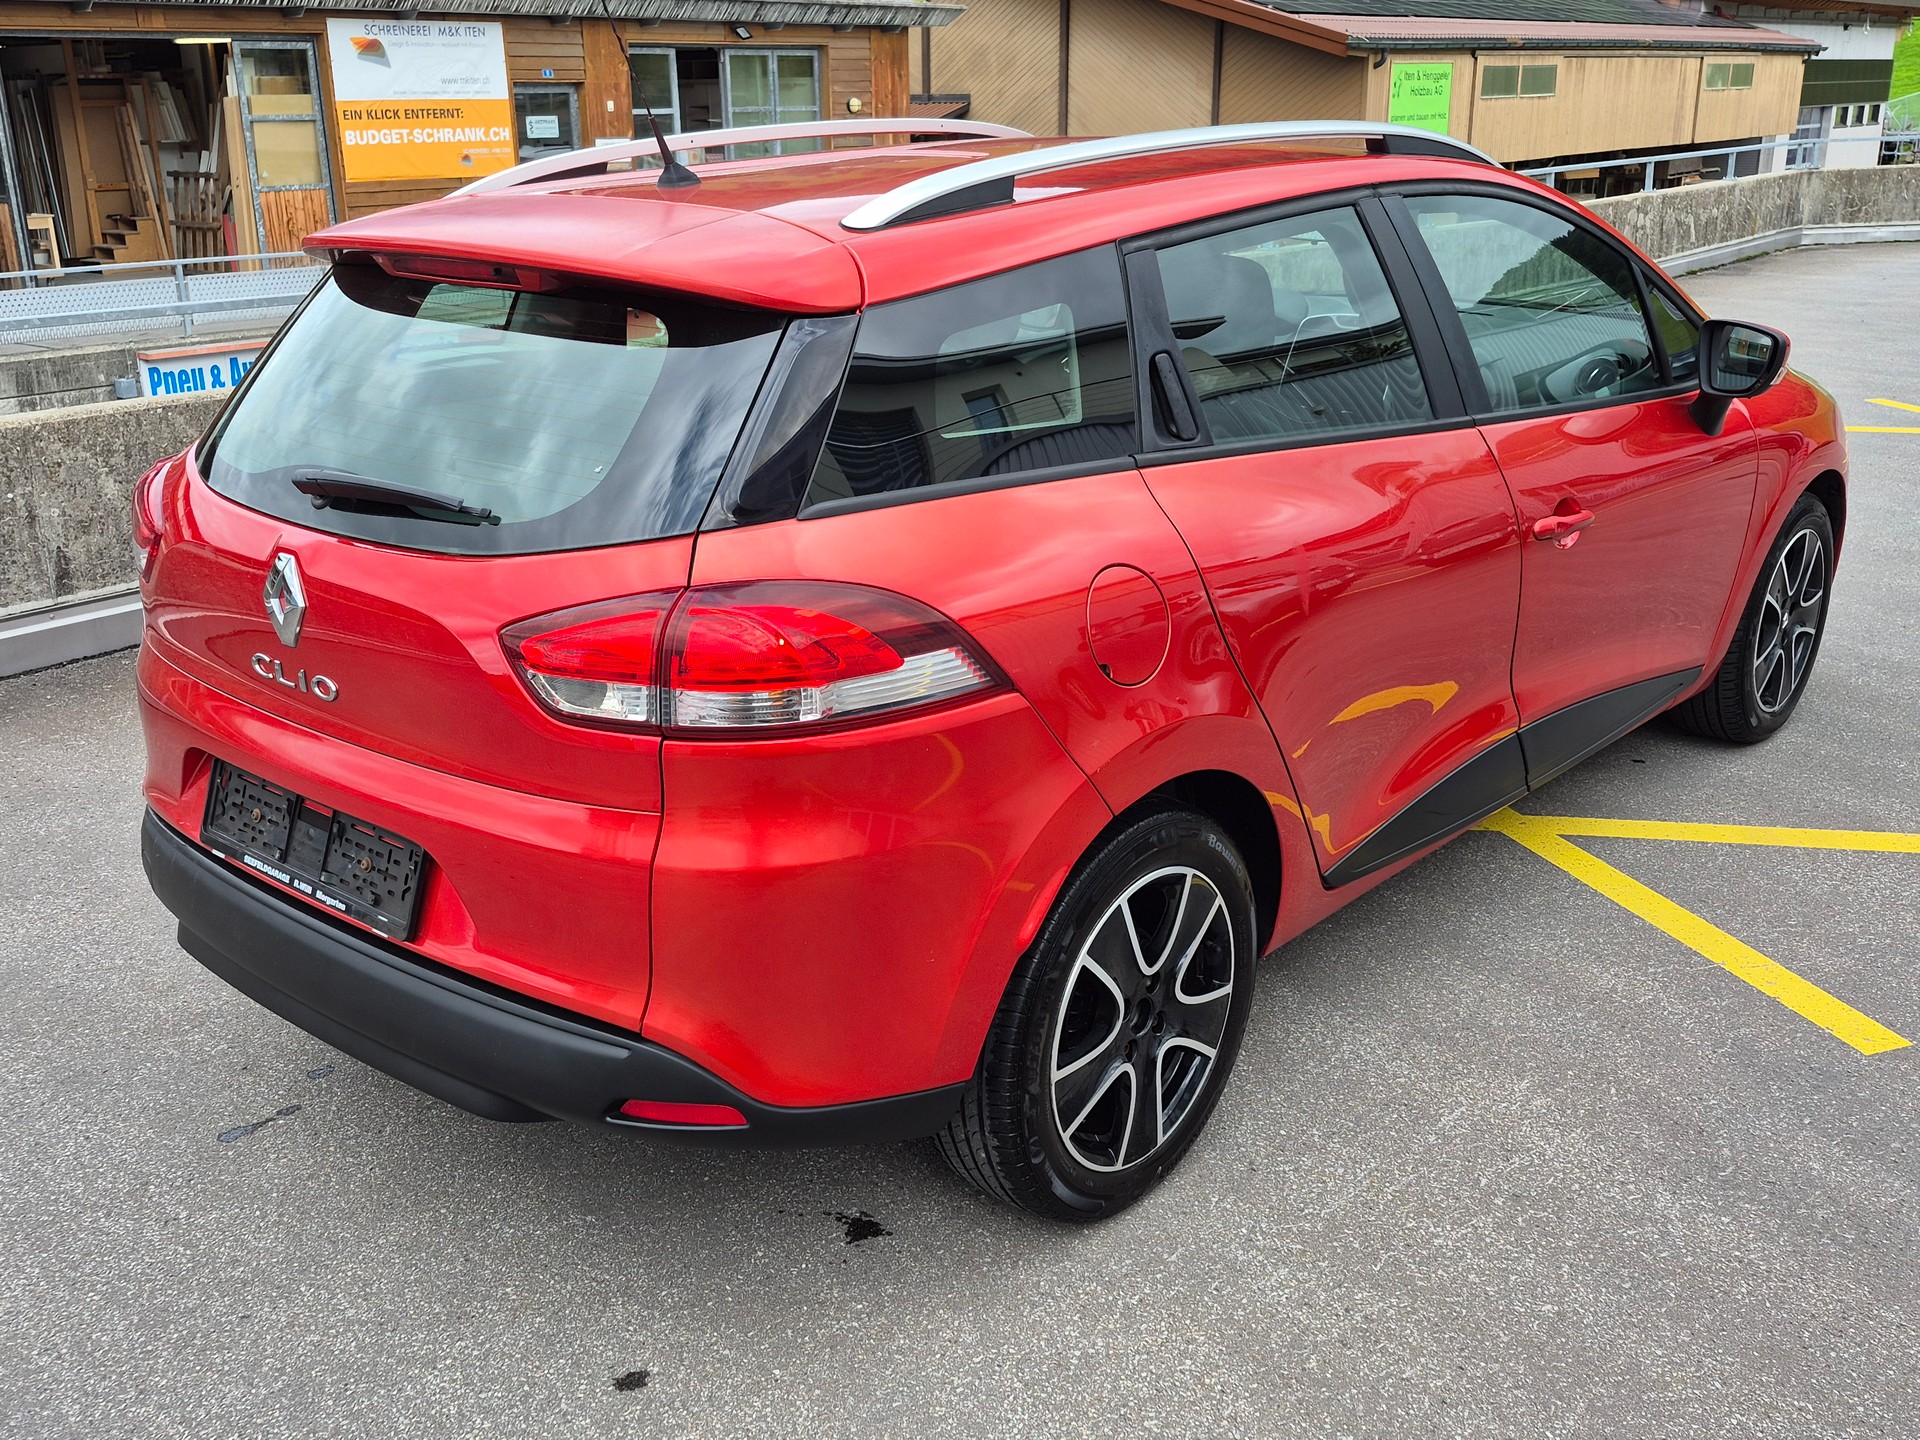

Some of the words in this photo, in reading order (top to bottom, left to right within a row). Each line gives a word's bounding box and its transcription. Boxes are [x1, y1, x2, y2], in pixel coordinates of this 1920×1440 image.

[364, 24, 431, 36] SCHREINEREI
[438, 25, 462, 37] M&K
[464, 26, 486, 37] ITEN
[1416, 70, 1421, 80] &
[1422, 70, 1450, 83] Henggeler
[1410, 86, 1433, 96] Holzbau
[1434, 85, 1443, 96] AG
[343, 109, 362, 121] EIN
[367, 109, 400, 120] KLICK
[404, 108, 464, 120] ENTFERNT:
[345, 127, 510, 146] BUDGET-SCHRANK.CH
[147, 366, 206, 396] Pneu
[210, 364, 225, 389] &
[252, 652, 338, 702] CLIO
[1207, 833, 1238, 871] Barum
